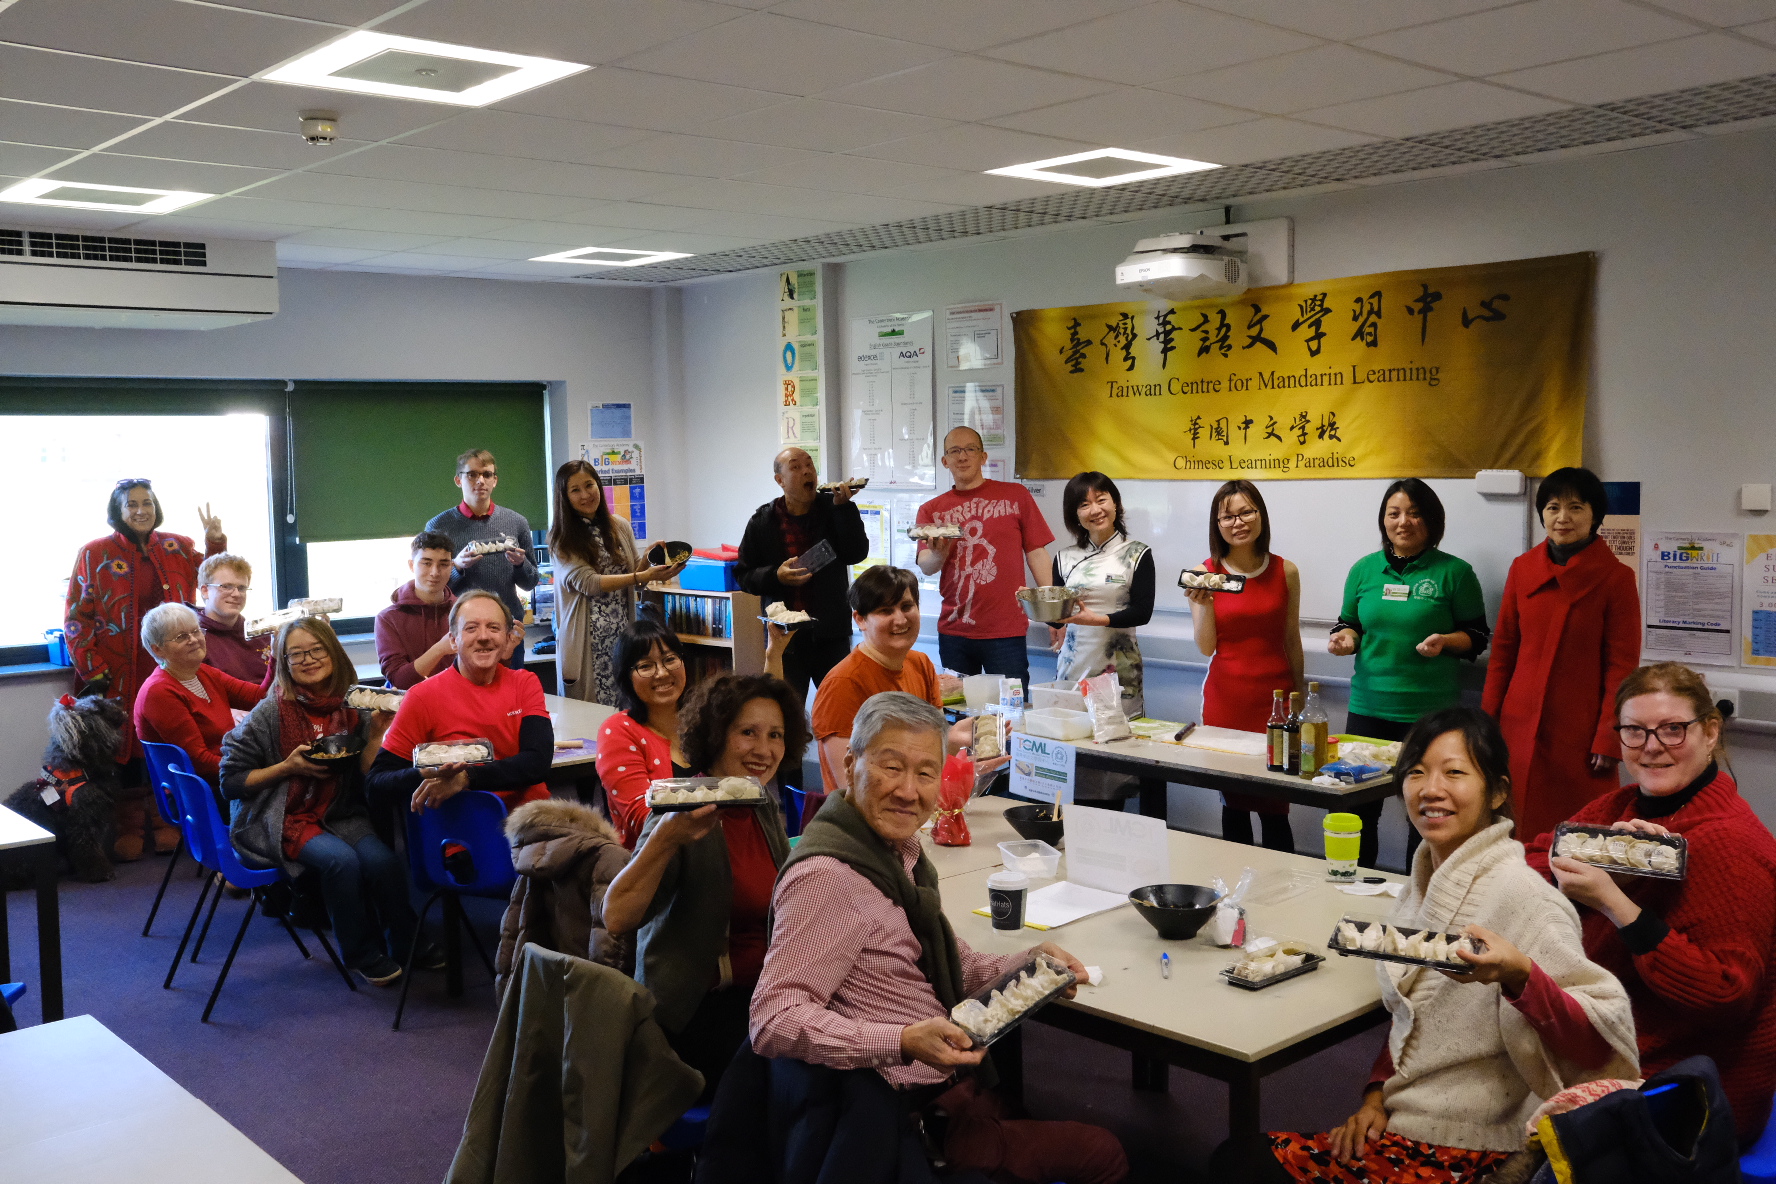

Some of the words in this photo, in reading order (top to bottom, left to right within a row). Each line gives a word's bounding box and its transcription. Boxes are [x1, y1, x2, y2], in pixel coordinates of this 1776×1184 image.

[1059, 283, 1511, 375] 臺灣華語文學習中心
[898, 350, 919, 359] AQA
[1107, 380, 1162, 398] Taiwan
[1168, 377, 1221, 396] Centre
[1227, 372, 1253, 392] for
[1257, 366, 1344, 391] Mandarin
[1351, 360, 1440, 387] Learning
[1173, 455, 1224, 470] Chinese
[1228, 453, 1291, 473] Learning
[1295, 451, 1356, 469] Paradise
[1664, 563, 1699, 571] Punctuation
[1016, 736, 1050, 756] TCML
